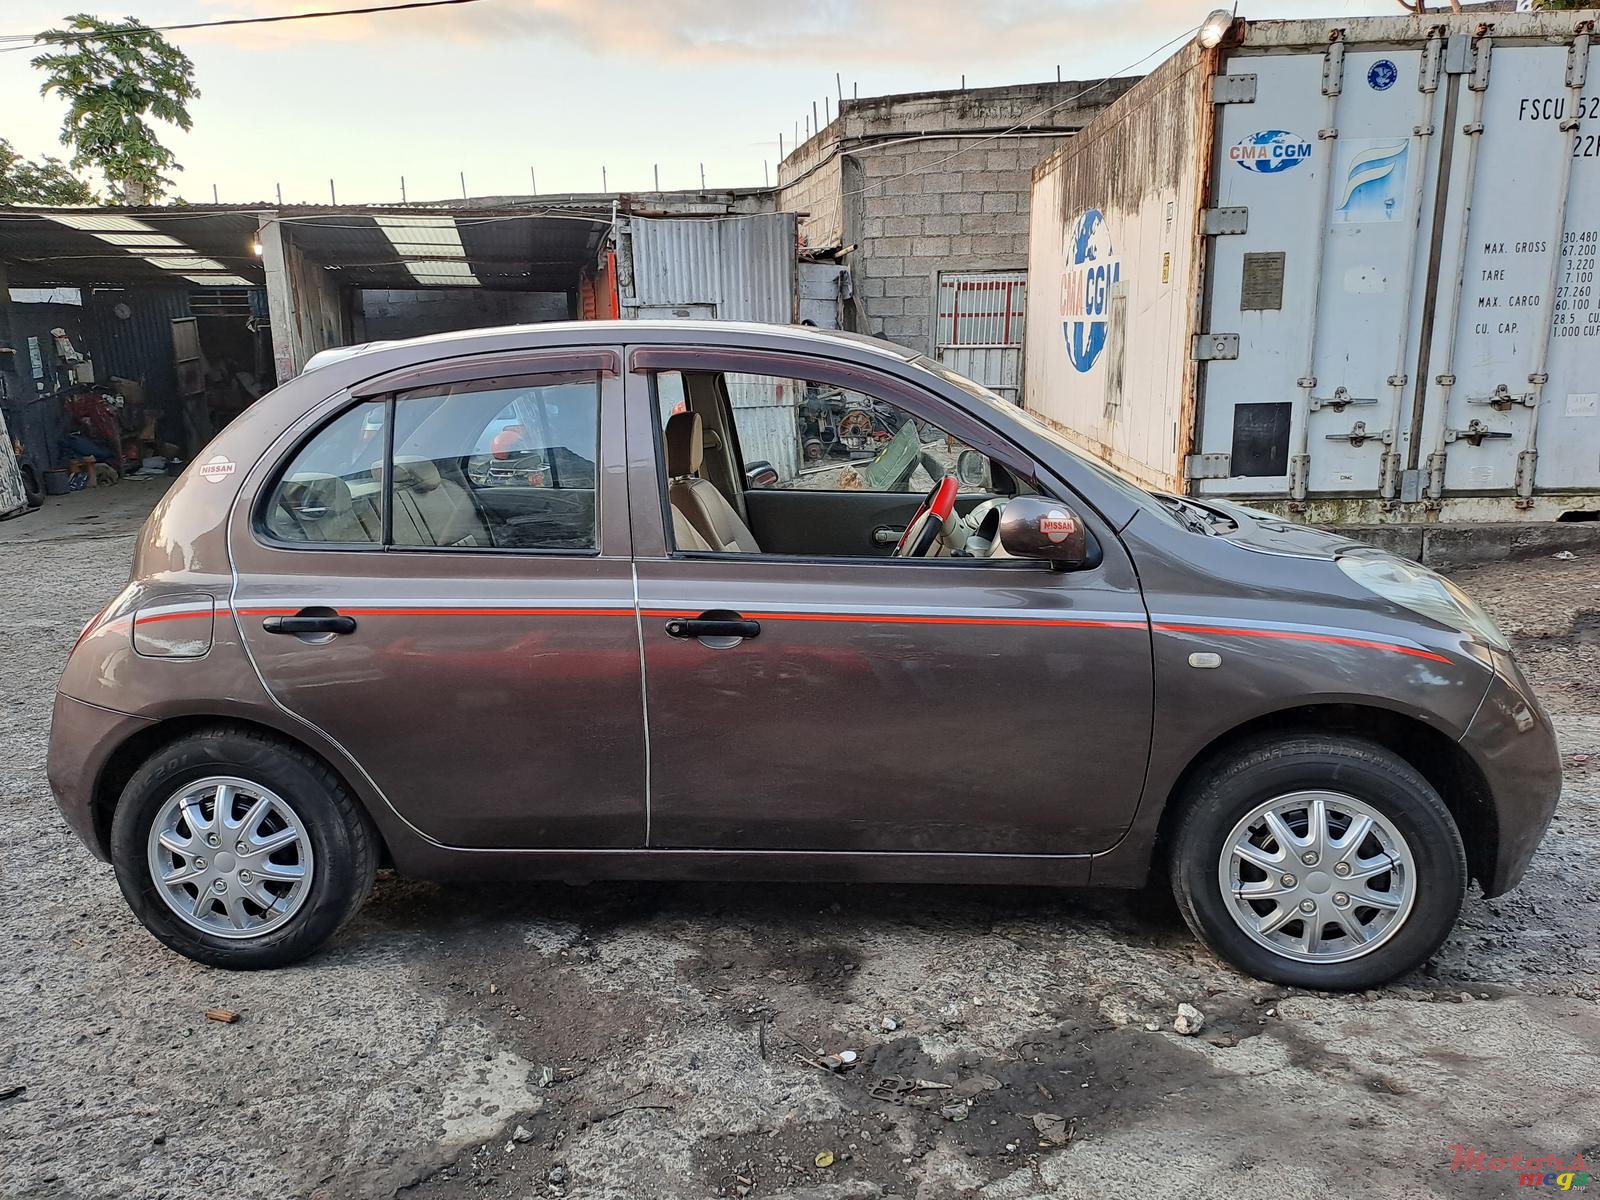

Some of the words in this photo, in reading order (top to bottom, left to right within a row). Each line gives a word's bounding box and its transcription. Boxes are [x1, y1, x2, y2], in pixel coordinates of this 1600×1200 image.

[1519, 98, 1565, 120] FSCU
[1230, 146, 1267, 159] CMA
[1273, 143, 1312, 158] CGM
[1563, 231, 1598, 243] 30.480
[1484, 243, 1508, 254] MAX.
[1515, 241, 1547, 253] GROSS
[1562, 244, 1597, 256] 67.200
[1566, 258, 1595, 270] 3.220
[1482, 269, 1505, 281] TARE
[1565, 271, 1593, 283] 7.100
[1059, 270, 1083, 316] CMA
[1085, 262, 1120, 315] CGM
[1556, 285, 1591, 298] 27.260
[1478, 297, 1501, 308] MAX.
[1555, 298, 1590, 310] 60.100
[1553, 313, 1575, 325] 28.5
[1475, 323, 1490, 334] CU.
[1498, 322, 1519, 334] CAP.
[1553, 325, 1580, 337] 1.000
[202, 464, 233, 474] NISSAN
[1044, 521, 1072, 530] NISSAN
